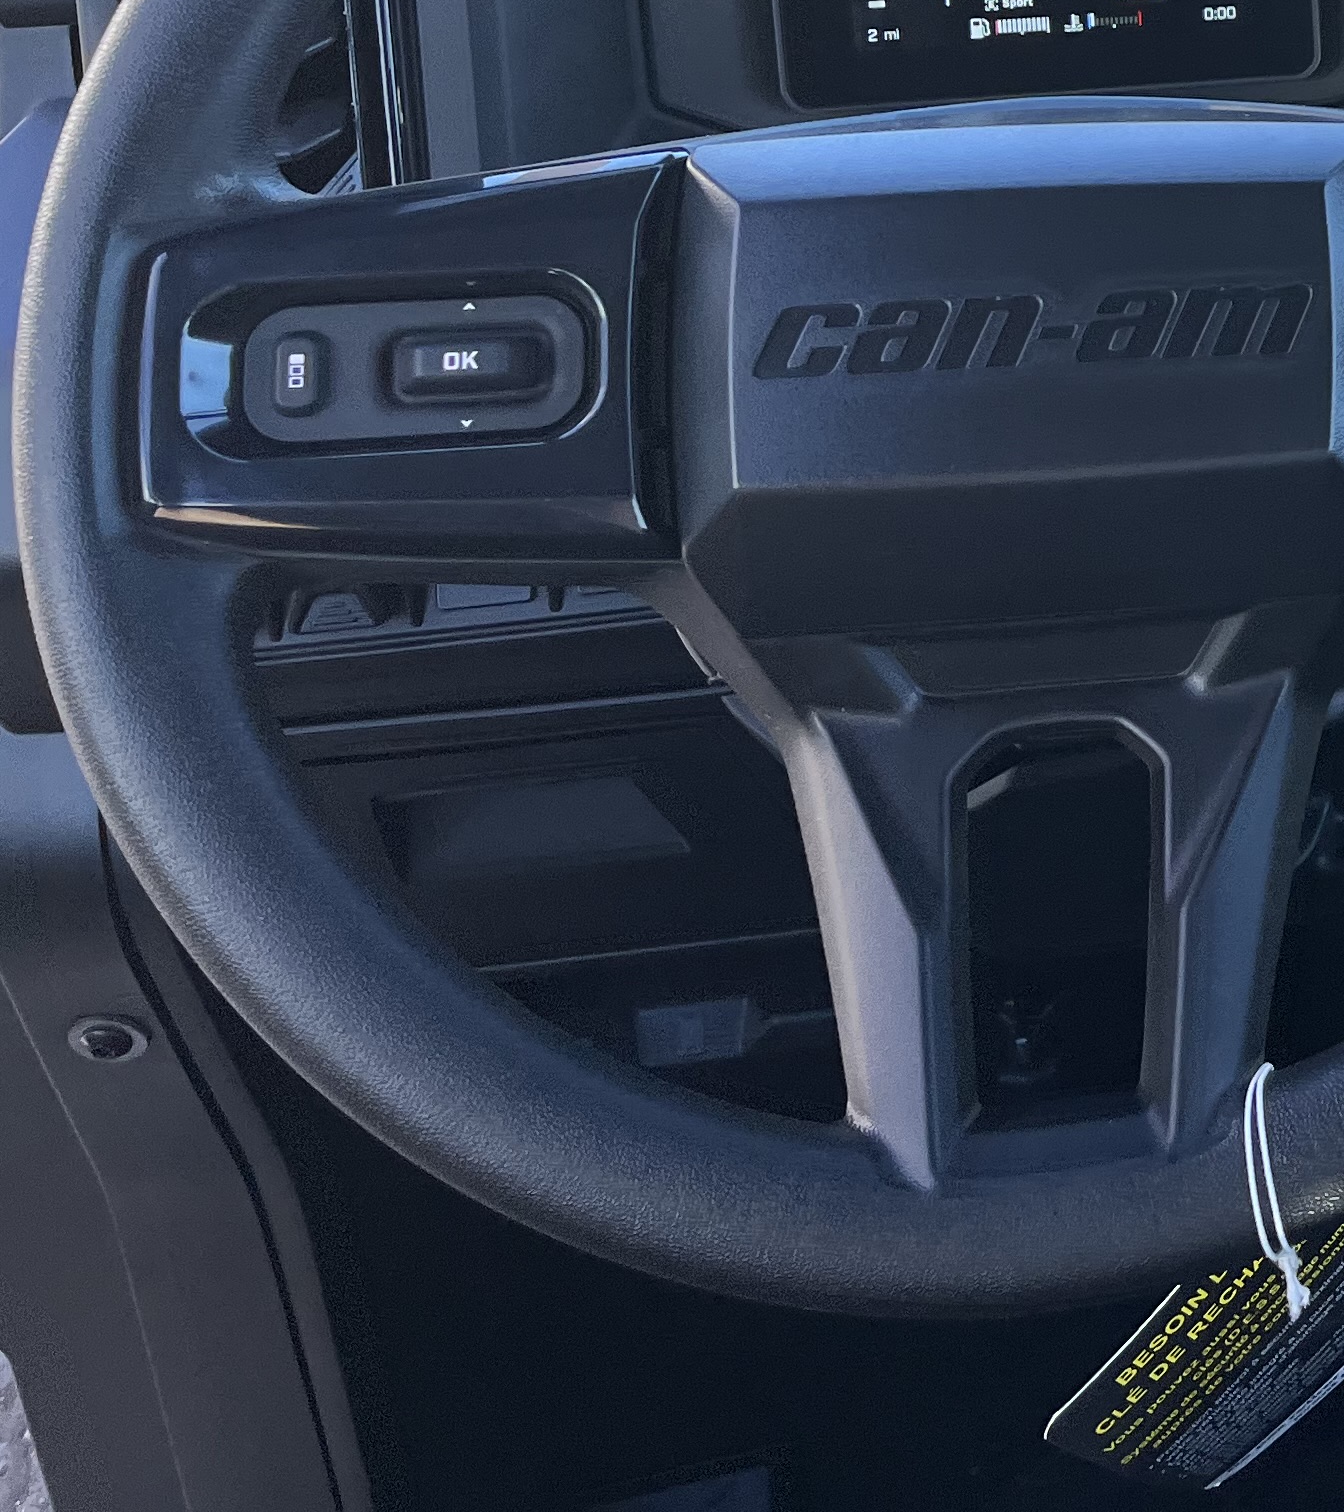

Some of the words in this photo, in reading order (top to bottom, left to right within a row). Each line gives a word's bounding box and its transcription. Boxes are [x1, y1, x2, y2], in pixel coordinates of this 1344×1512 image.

[867, 28, 879, 43] 2
[884, 27, 900, 41] mi
[1204, 5, 1237, 21] 0:00
[443, 350, 478, 371] OK
[752, 283, 1315, 380] can-am
[1115, 1287, 1209, 1388] BESOIN
[1308, 1293, 1335, 1322] puce
[1094, 1381, 1147, 1438] CLÉ
[1149, 1343, 1185, 1382] DE
[1185, 1253, 1267, 1341] RECHA
[1103, 1413, 1143, 1455] Vous
[1146, 1357, 1199, 1414] pouvez
[1201, 1314, 1240, 1356] aussi
[1241, 1273, 1277, 1311] vous
[1120, 1405, 1179, 1468] Système
[1179, 1388, 1198, 1407] de
[1197, 1332, 1249, 1388] sécurité
[1258, 1255, 1320, 1322] encage
[1190, 1347, 1222, 1381] clés
[1204, 1375, 1223, 1395] de
[1224, 1333, 1261, 1373] votre
